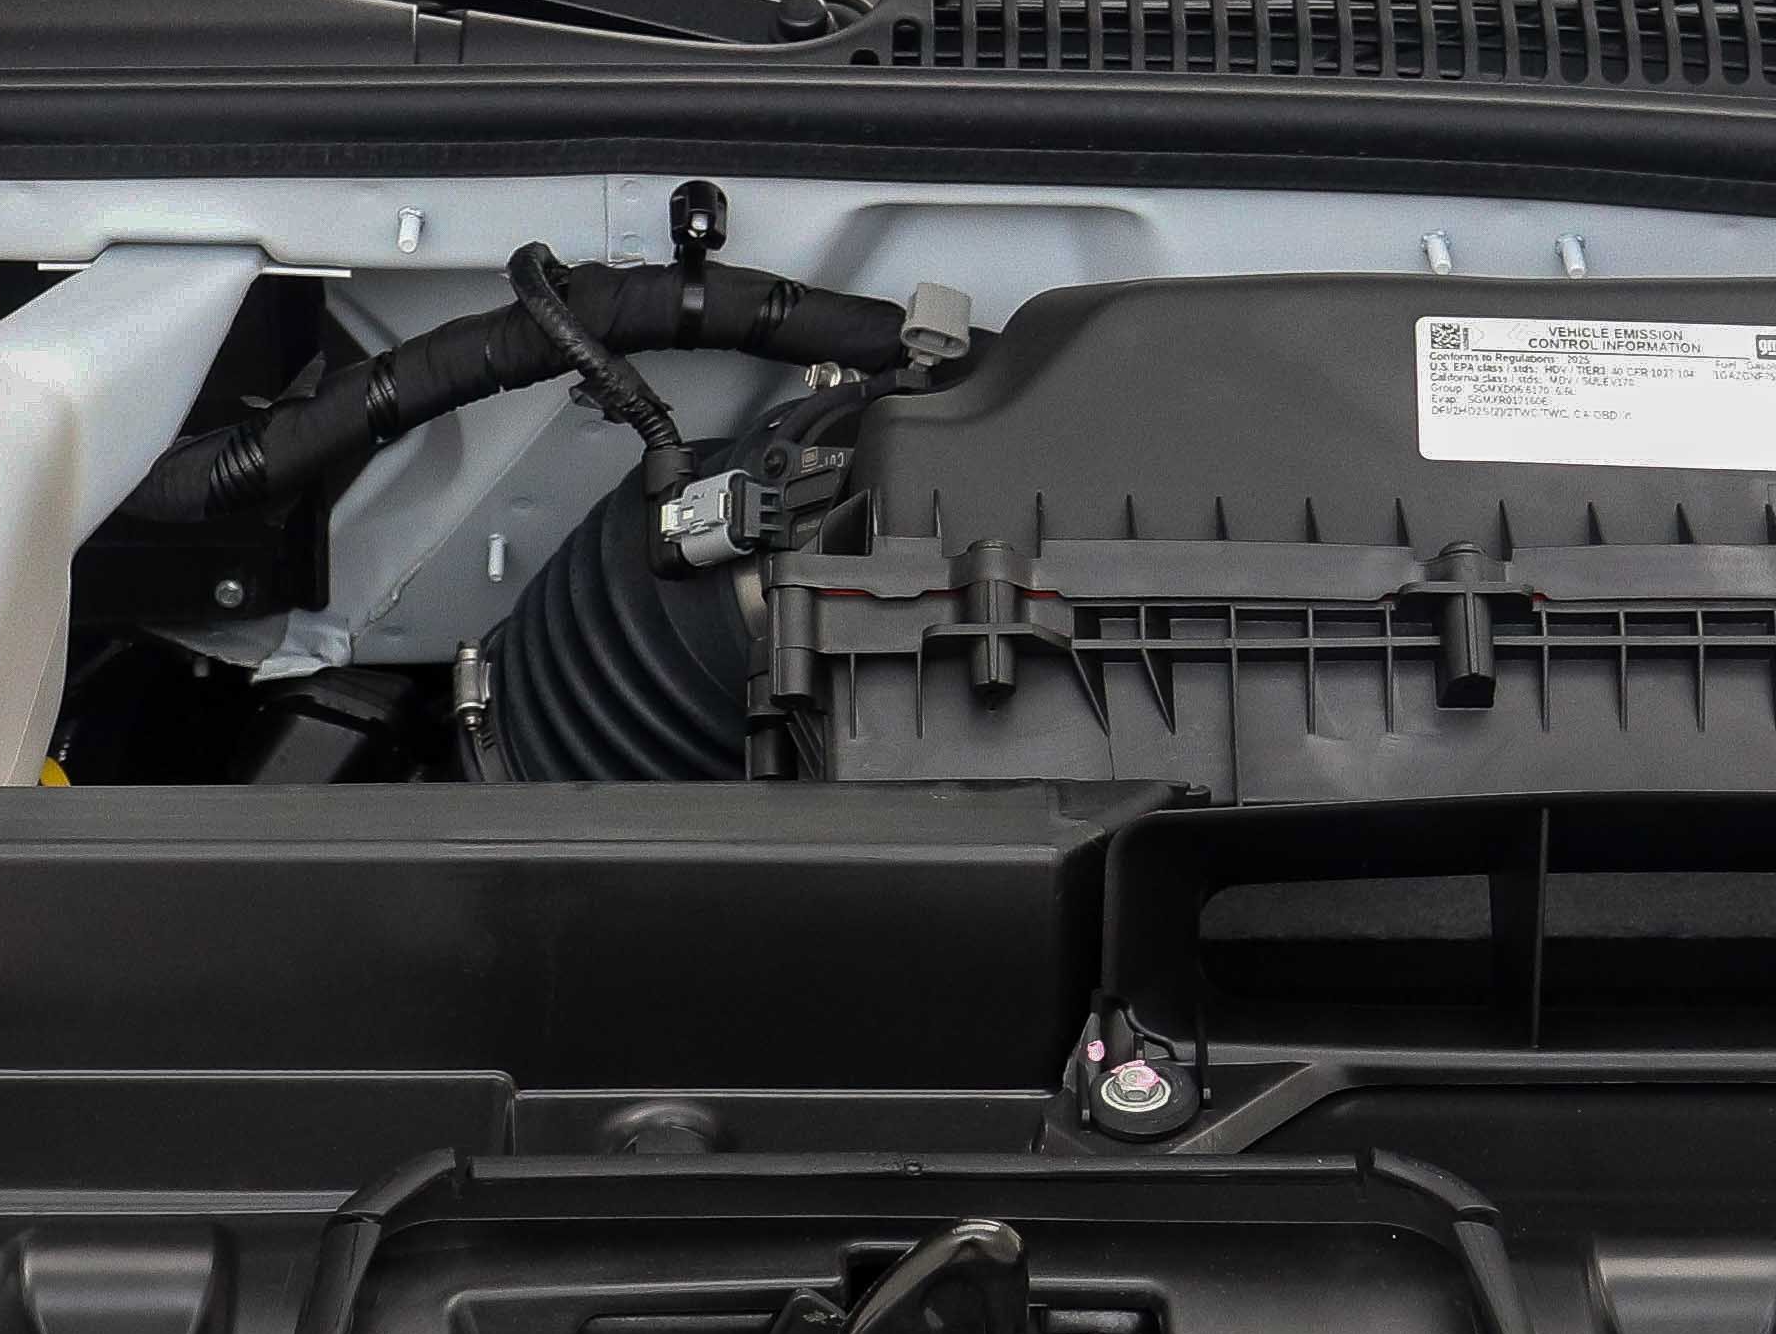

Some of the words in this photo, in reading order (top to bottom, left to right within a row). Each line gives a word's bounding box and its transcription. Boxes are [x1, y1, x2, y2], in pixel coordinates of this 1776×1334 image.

[1548, 327, 1609, 340] VEHICLE
[1614, 328, 1683, 341] EMISSION
[1528, 338, 1599, 351] CONTROL
[1602, 340, 1701, 354] INFORMATION
[1429, 351, 1479, 361] Conforms
[1482, 353, 1492, 362] to
[1453, 363, 1474, 372] EPA
[1477, 363, 1504, 372] class
[1430, 373, 1479, 383] California
